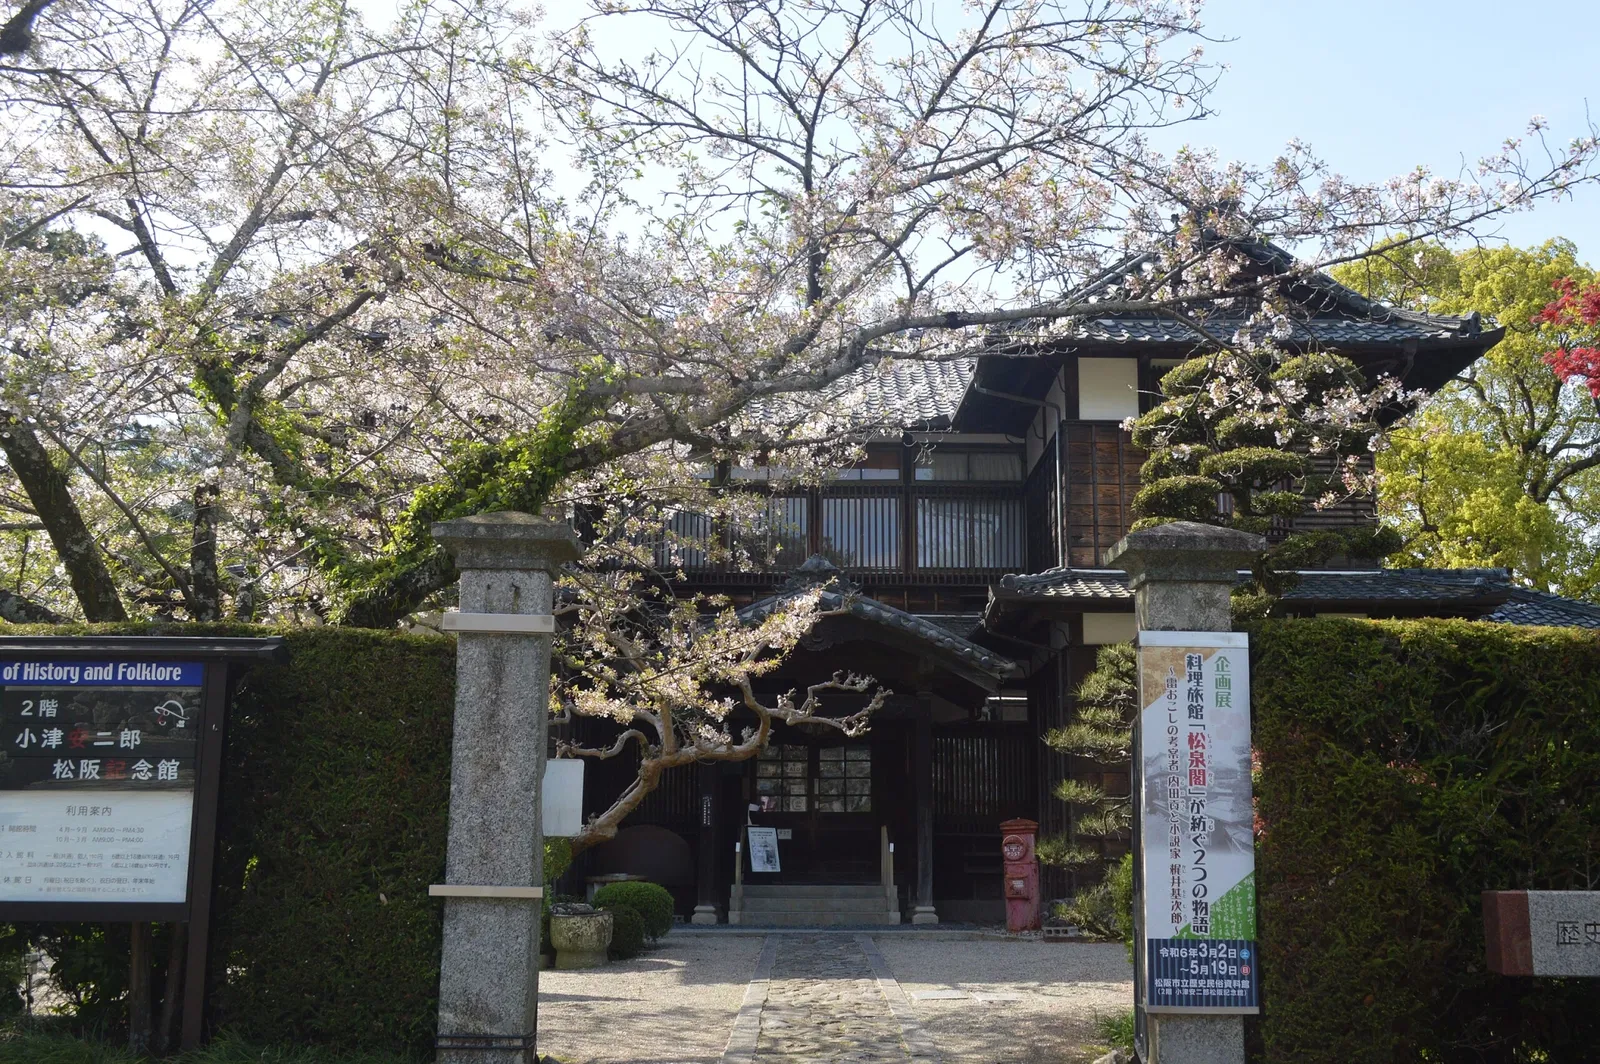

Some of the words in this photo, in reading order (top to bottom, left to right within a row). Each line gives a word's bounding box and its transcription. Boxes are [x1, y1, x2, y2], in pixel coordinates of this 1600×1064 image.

[3, 663, 20, 681] of
[23, 663, 79, 684] History
[84, 663, 113, 681] and
[117, 663, 182, 681] Folklore
[1215, 656, 1232, 708] 企画展
[21, 699, 58, 718] 2階
[15, 728, 141, 749] 小津安二郎
[53, 759, 180, 780] 松阪記念館
[66, 805, 112, 816] 利用案内
[1556, 921, 1600, 946] 歴史
[1159, 943, 1237, 959] 令和6年3月2日
[1154, 978, 1250, 988] 松阪市立歴史民俗資料館
